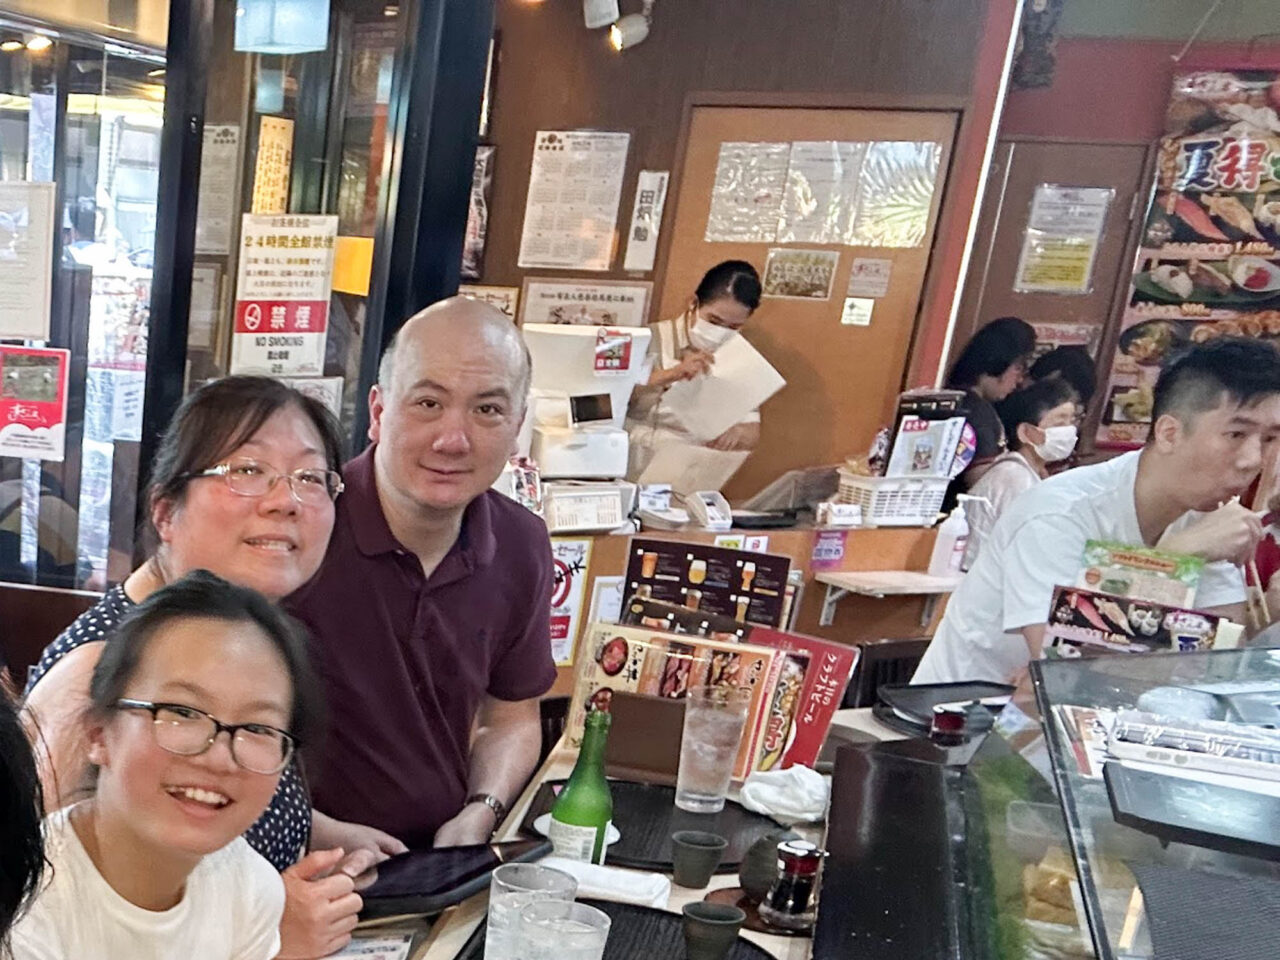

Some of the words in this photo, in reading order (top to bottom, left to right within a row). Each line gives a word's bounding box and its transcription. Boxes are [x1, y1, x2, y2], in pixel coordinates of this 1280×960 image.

[270, 305, 312, 329] 禁煙
[255, 336, 266, 347] NO
[268, 336, 304, 346] SMOKING
[803, 652, 838, 724] クラフトビール
